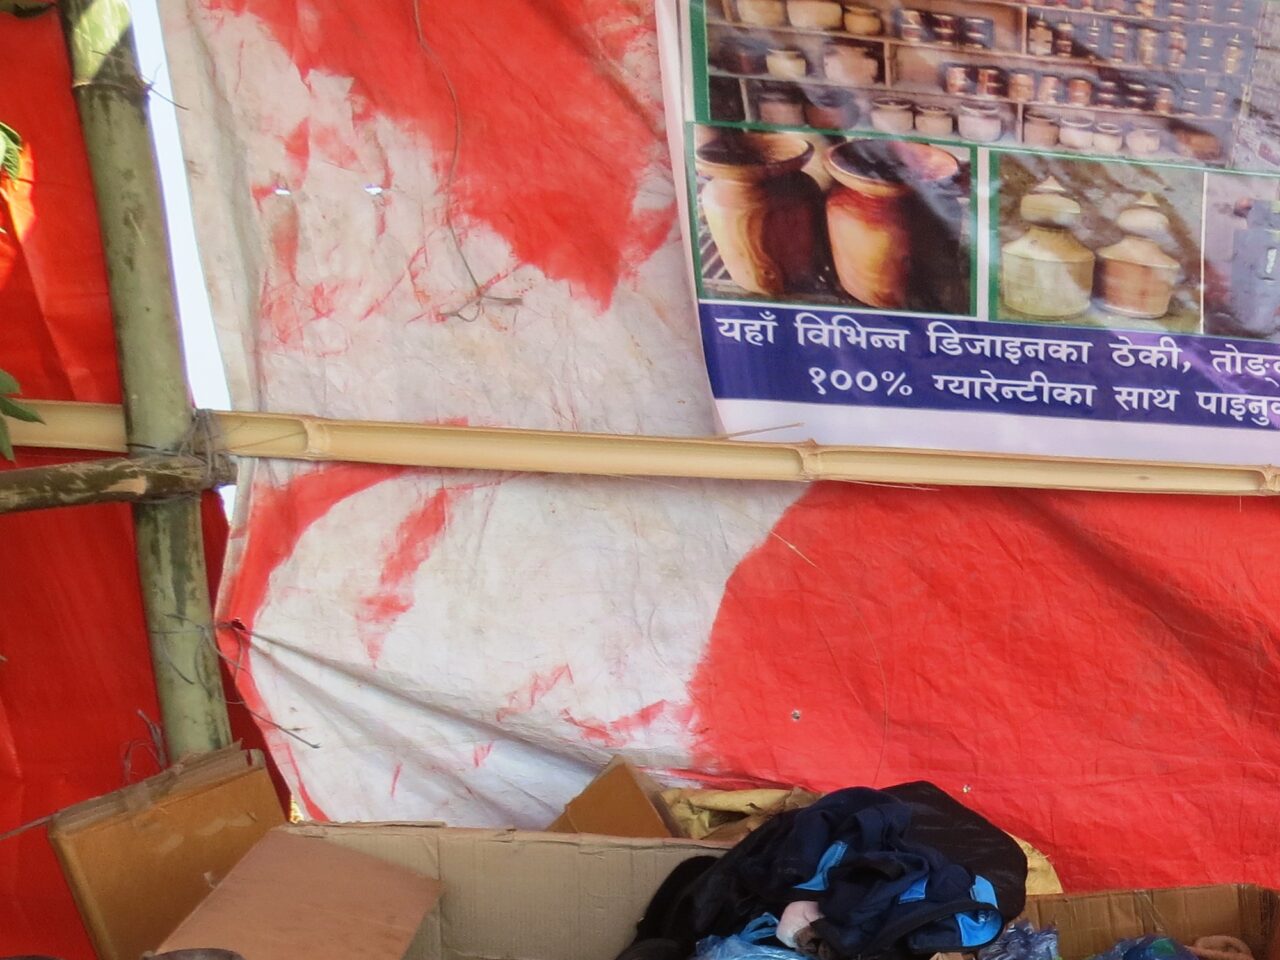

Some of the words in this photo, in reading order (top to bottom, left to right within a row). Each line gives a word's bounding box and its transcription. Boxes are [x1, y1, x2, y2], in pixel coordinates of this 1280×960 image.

[715, 311, 778, 346] यहाँ
[794, 312, 910, 351] विभिन्न
[926, 322, 1093, 364] डिजाइनका
[1109, 336, 1191, 373] ठेकी,
[808, 366, 913, 396] १००%
[932, 370, 1097, 407] ग्यारेन्टीका
[1112, 385, 1180, 411] साथ
